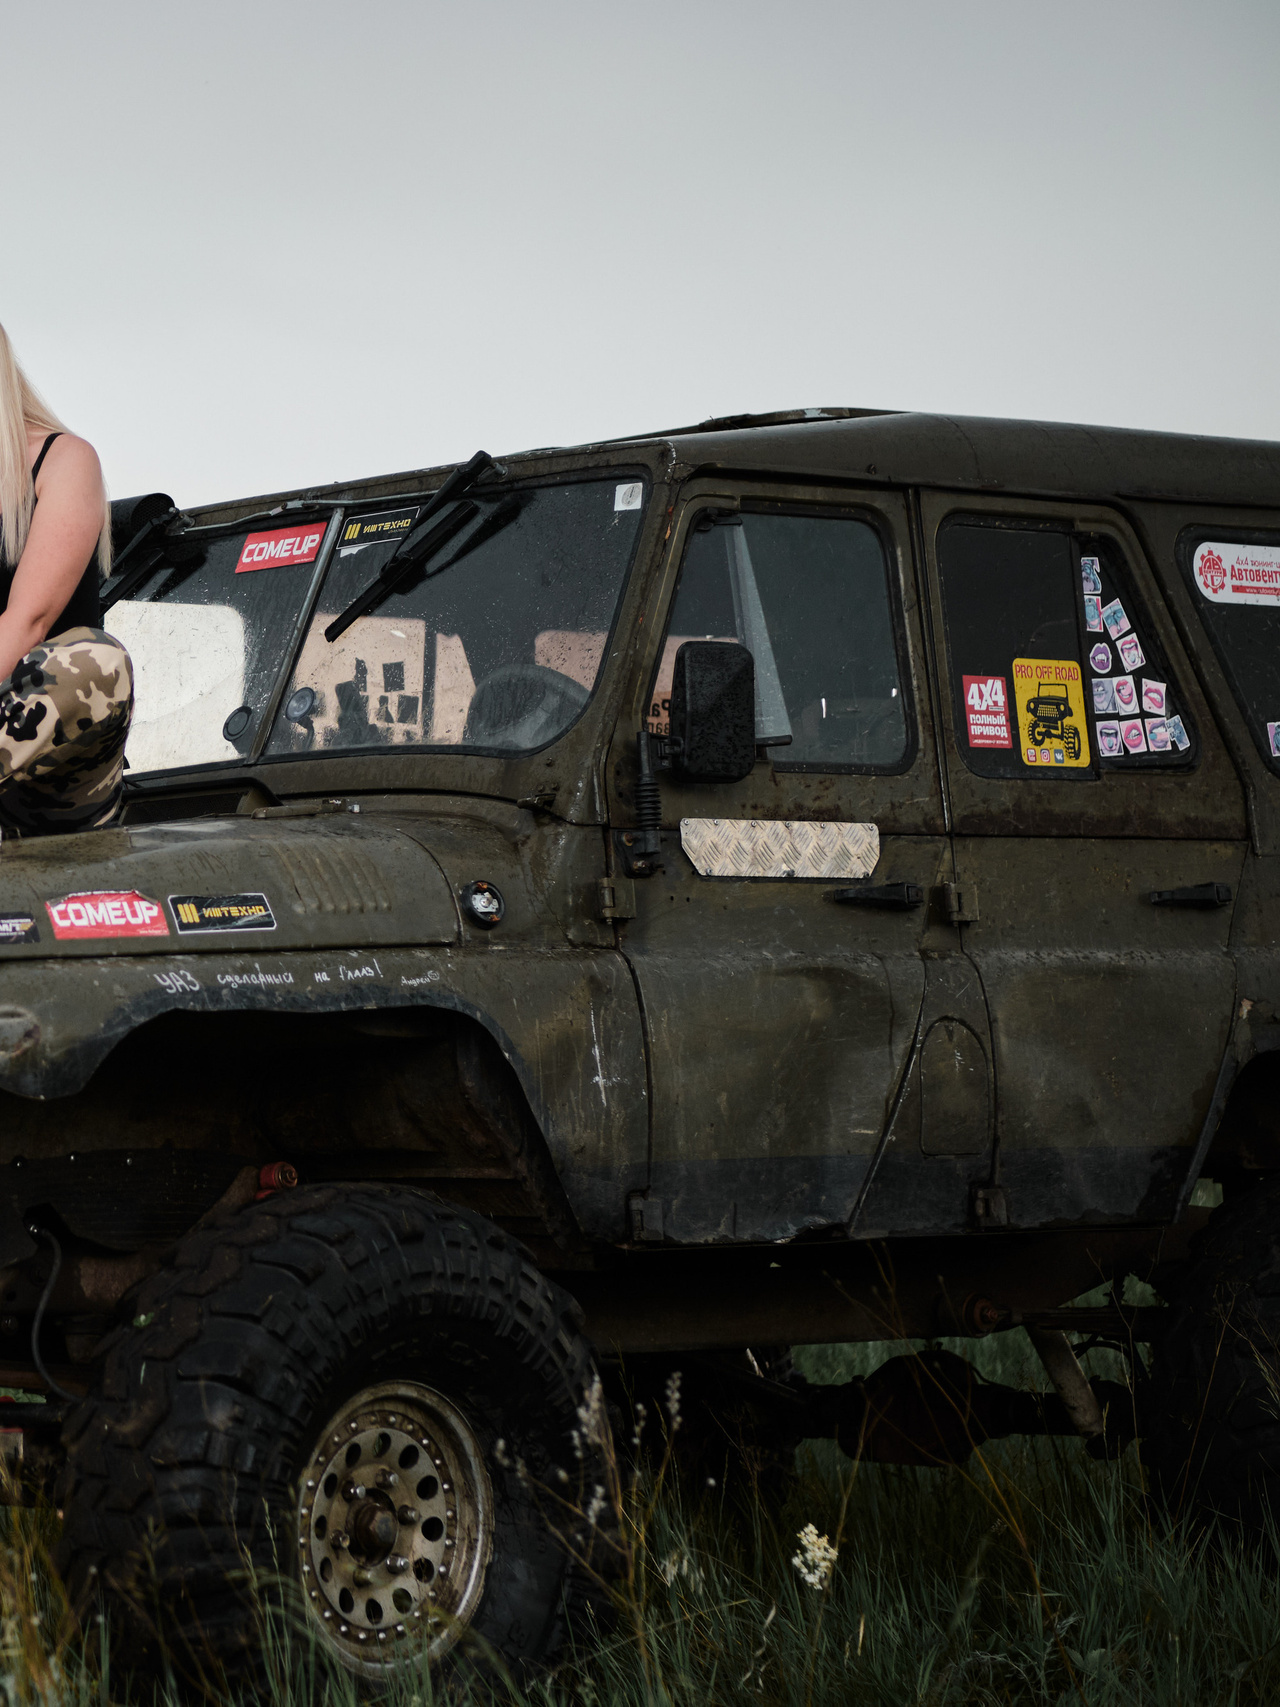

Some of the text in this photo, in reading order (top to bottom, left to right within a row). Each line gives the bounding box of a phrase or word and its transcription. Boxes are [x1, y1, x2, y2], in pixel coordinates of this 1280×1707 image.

[242, 534, 320, 563] COMEUP
[1015, 664, 1079, 681] PRO OFF ROAD
[969, 713, 1006, 726] ПОЛНЫЙ
[971, 725, 1008, 738] ПРИВОД
[51, 901, 159, 927] COMEUP
[154, 969, 200, 994] УАЗ
[314, 971, 331, 983] на
